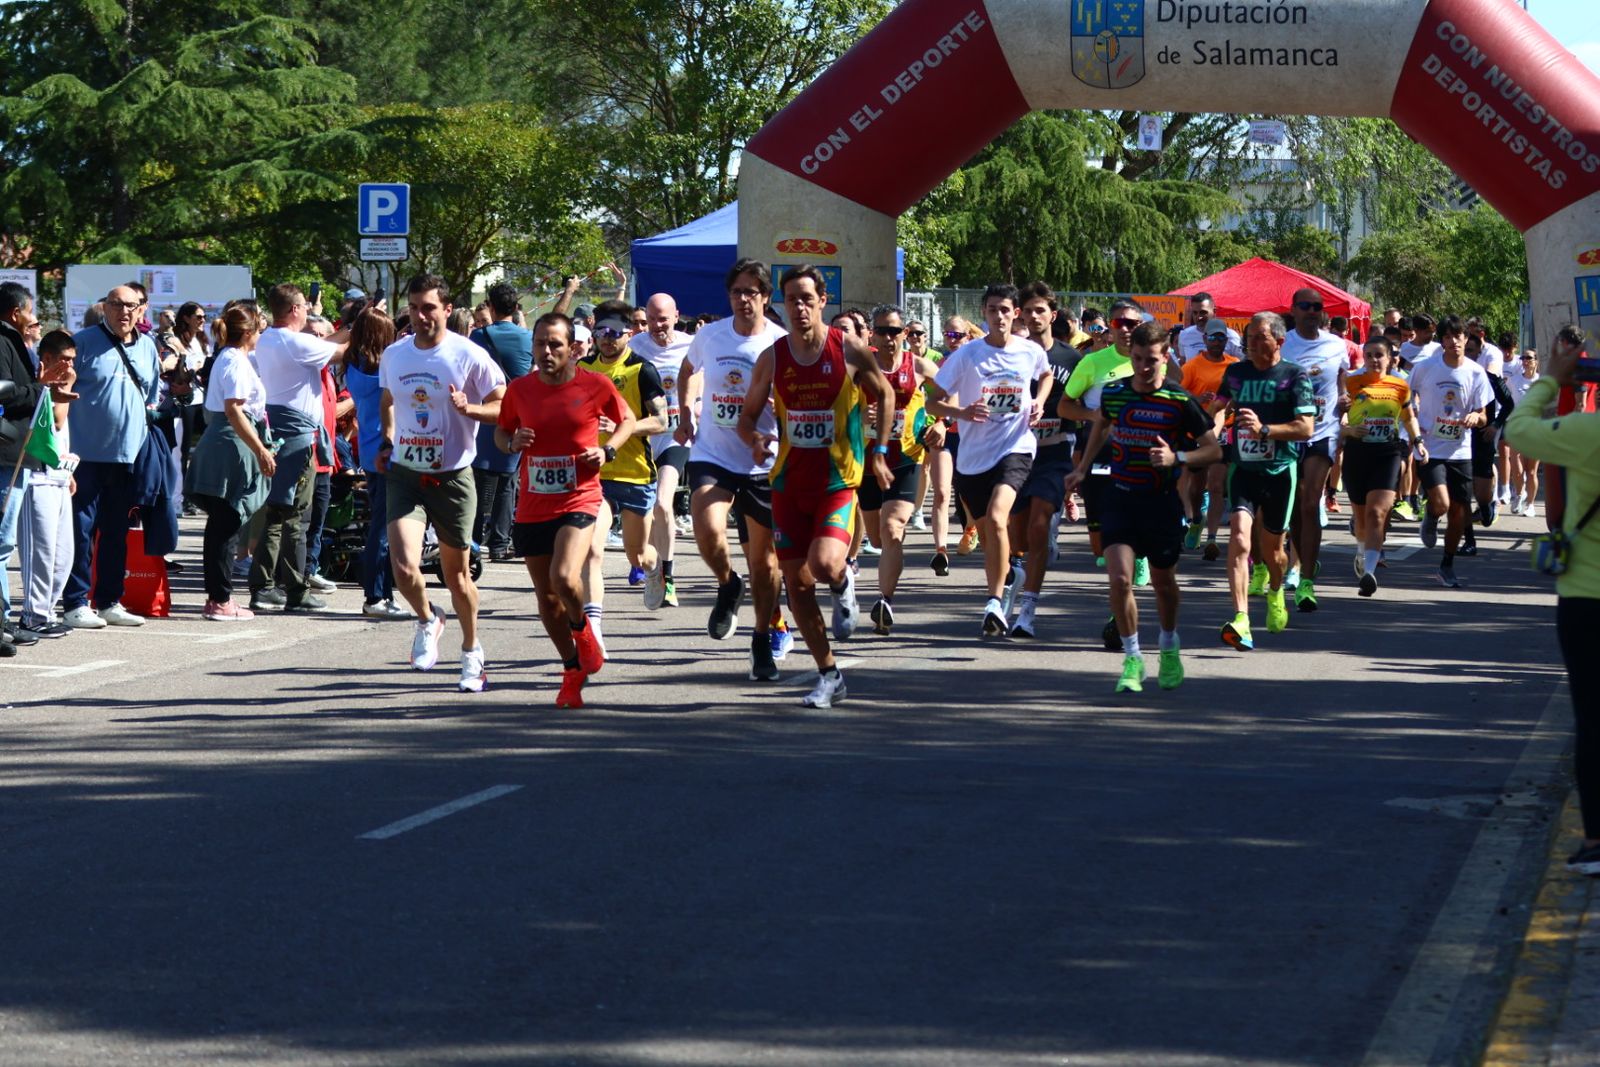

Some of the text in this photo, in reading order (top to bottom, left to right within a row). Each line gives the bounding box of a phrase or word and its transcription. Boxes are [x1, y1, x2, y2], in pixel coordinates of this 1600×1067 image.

[1157, 0, 1307, 29] Diputación
[1157, 40, 1339, 67] de Salamanca
[800, 10, 986, 174] CON EL DEPORTE
[1436, 21, 1600, 173] CON NUESTROS
[1421, 54, 1567, 189] DEPORTISTAS
[369, 190, 398, 232] P
[987, 394, 1016, 408] 472
[1239, 380, 1277, 403] AVS
[793, 423, 826, 440] 480
[1369, 425, 1390, 437] 478
[404, 446, 436, 463] 413
[1242, 440, 1268, 454] 425
[535, 469, 567, 485] 488
